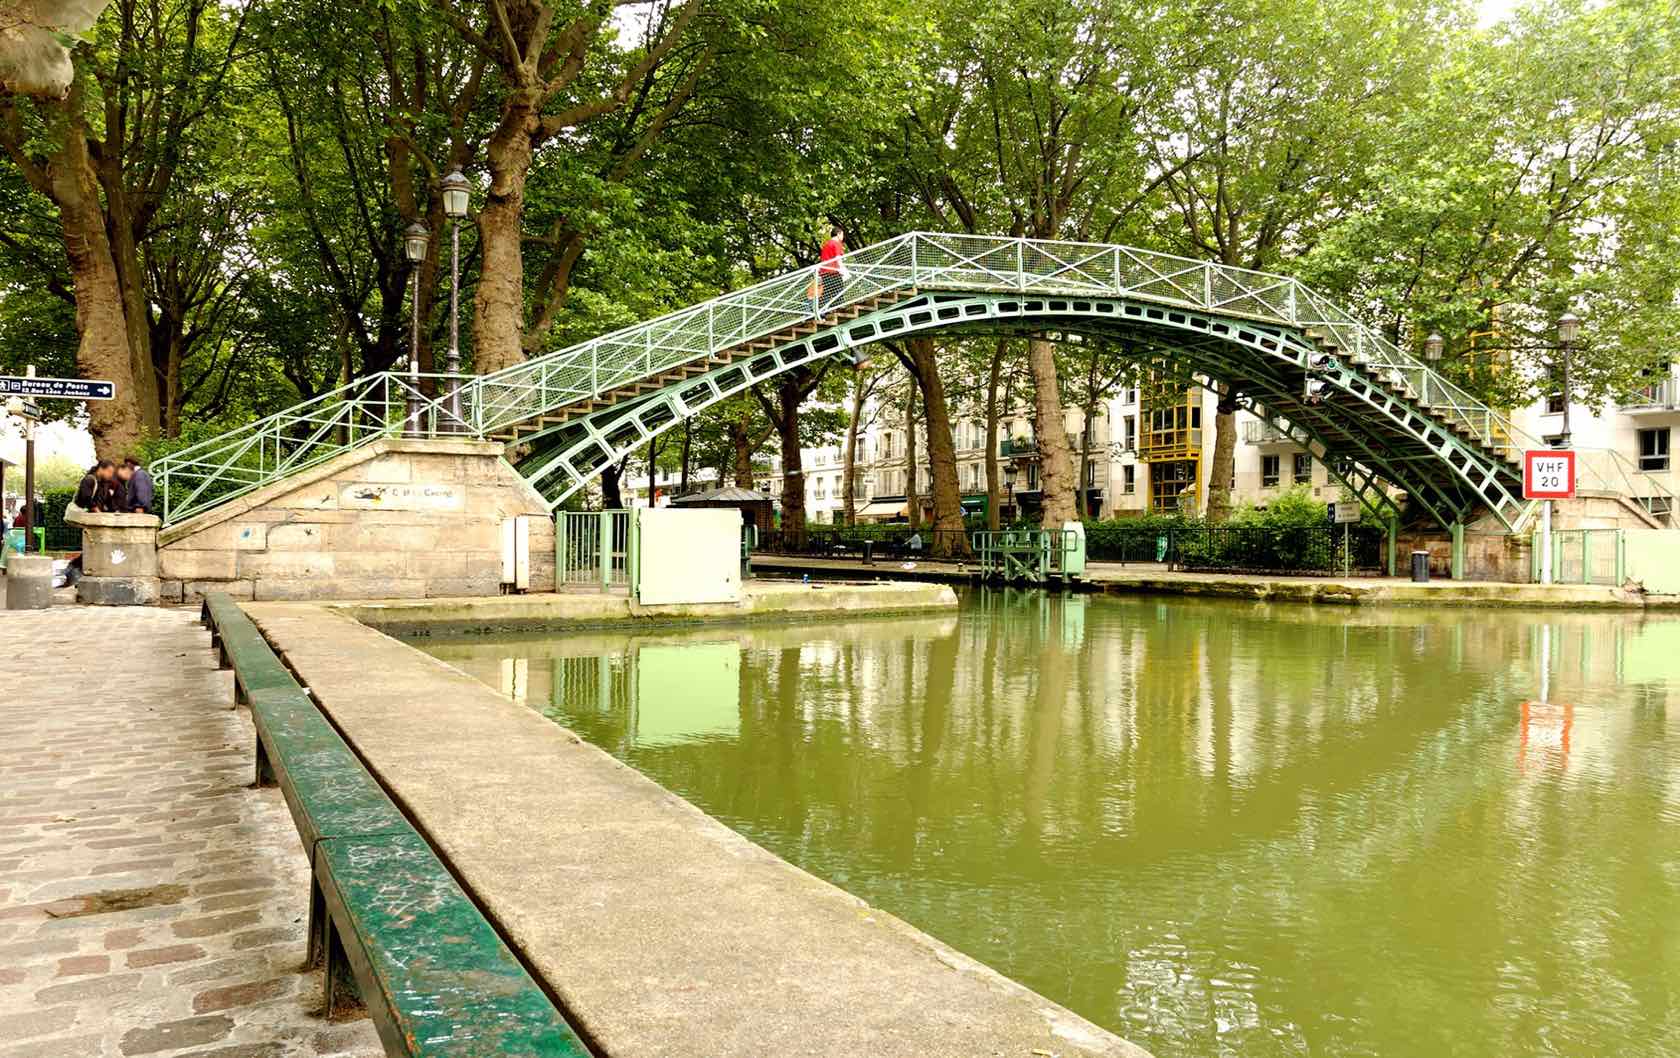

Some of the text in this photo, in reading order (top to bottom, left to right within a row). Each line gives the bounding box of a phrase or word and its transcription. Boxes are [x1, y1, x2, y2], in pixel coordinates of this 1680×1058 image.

[22, 380, 50, 388] Bureau
[1536, 462, 1564, 472] VHF
[1541, 476, 1559, 487] 20
